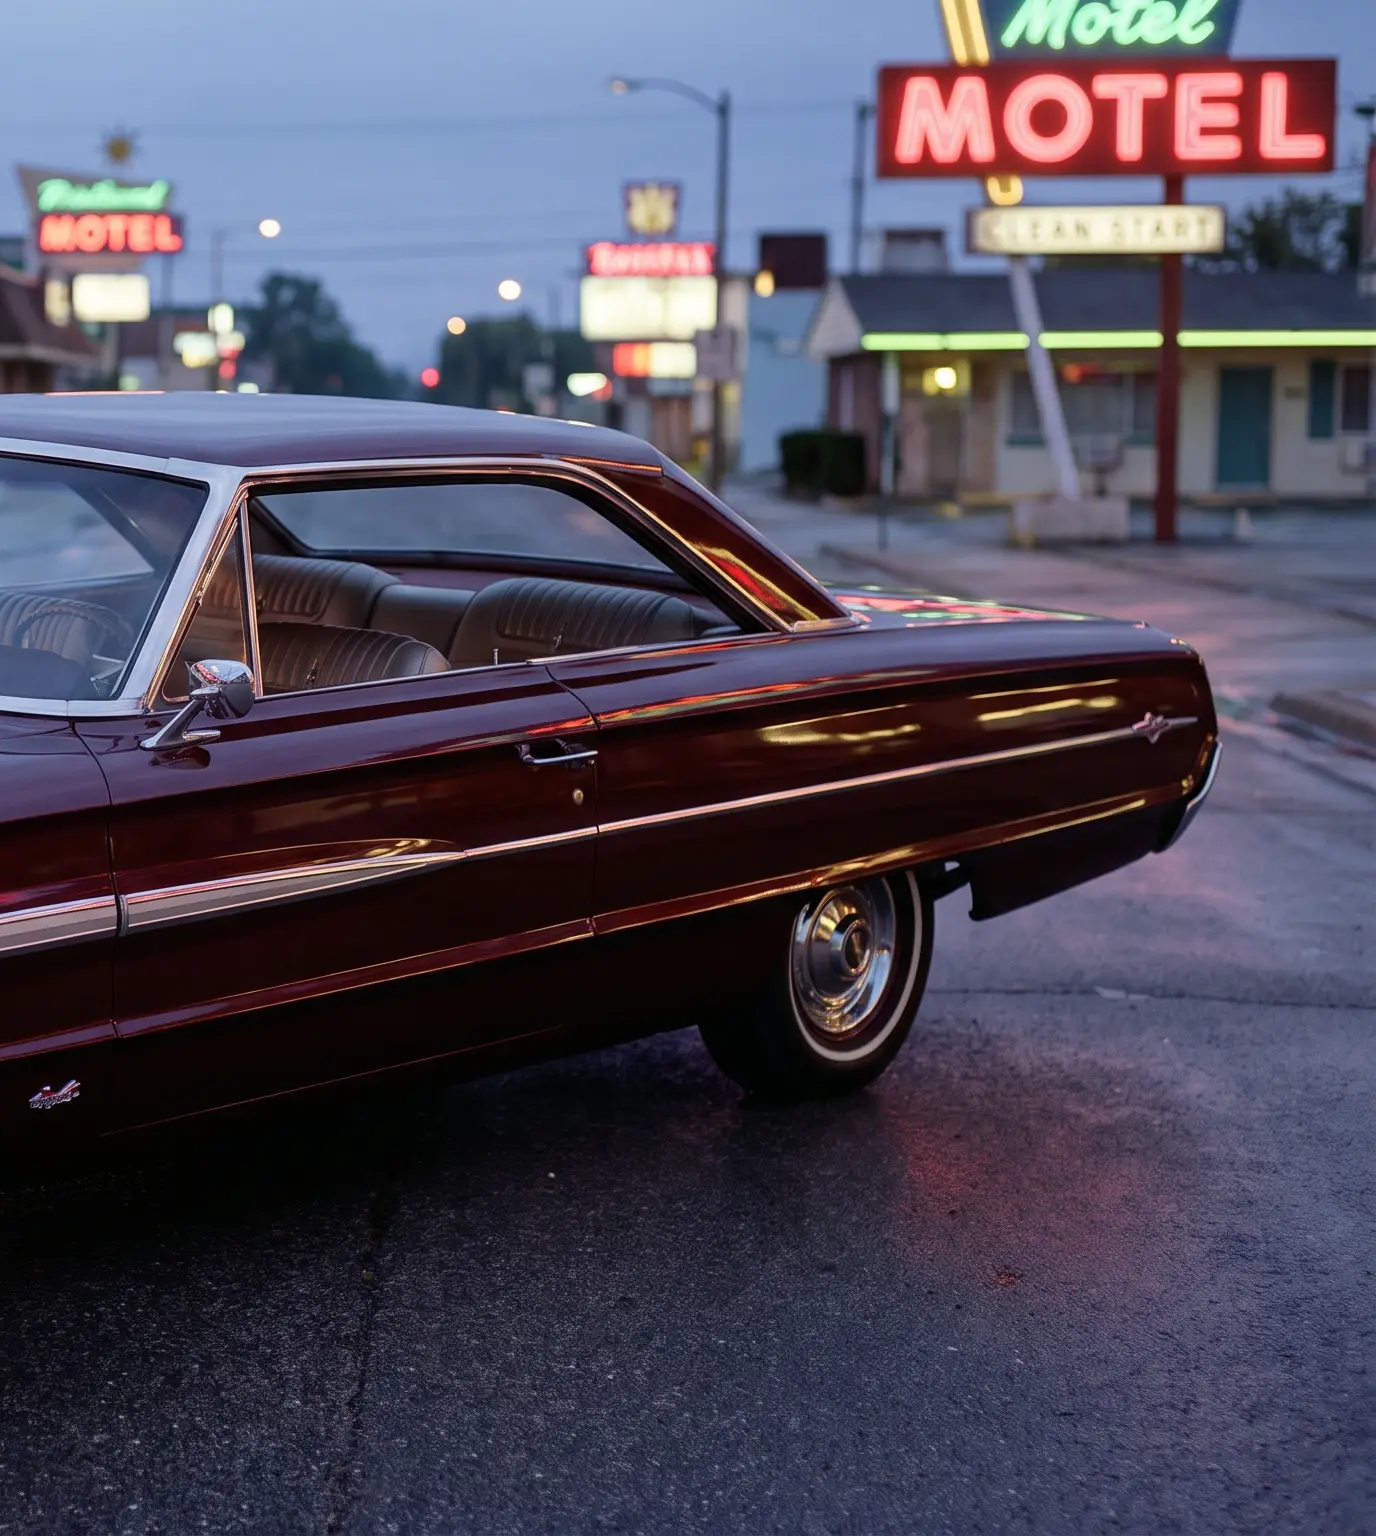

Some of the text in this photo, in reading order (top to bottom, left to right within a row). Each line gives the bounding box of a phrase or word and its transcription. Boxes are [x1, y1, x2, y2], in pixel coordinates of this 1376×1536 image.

[1000, 0, 1218, 50] Motel
[894, 71, 1326, 164] MOTEL
[39, 214, 184, 253] MOTEL
